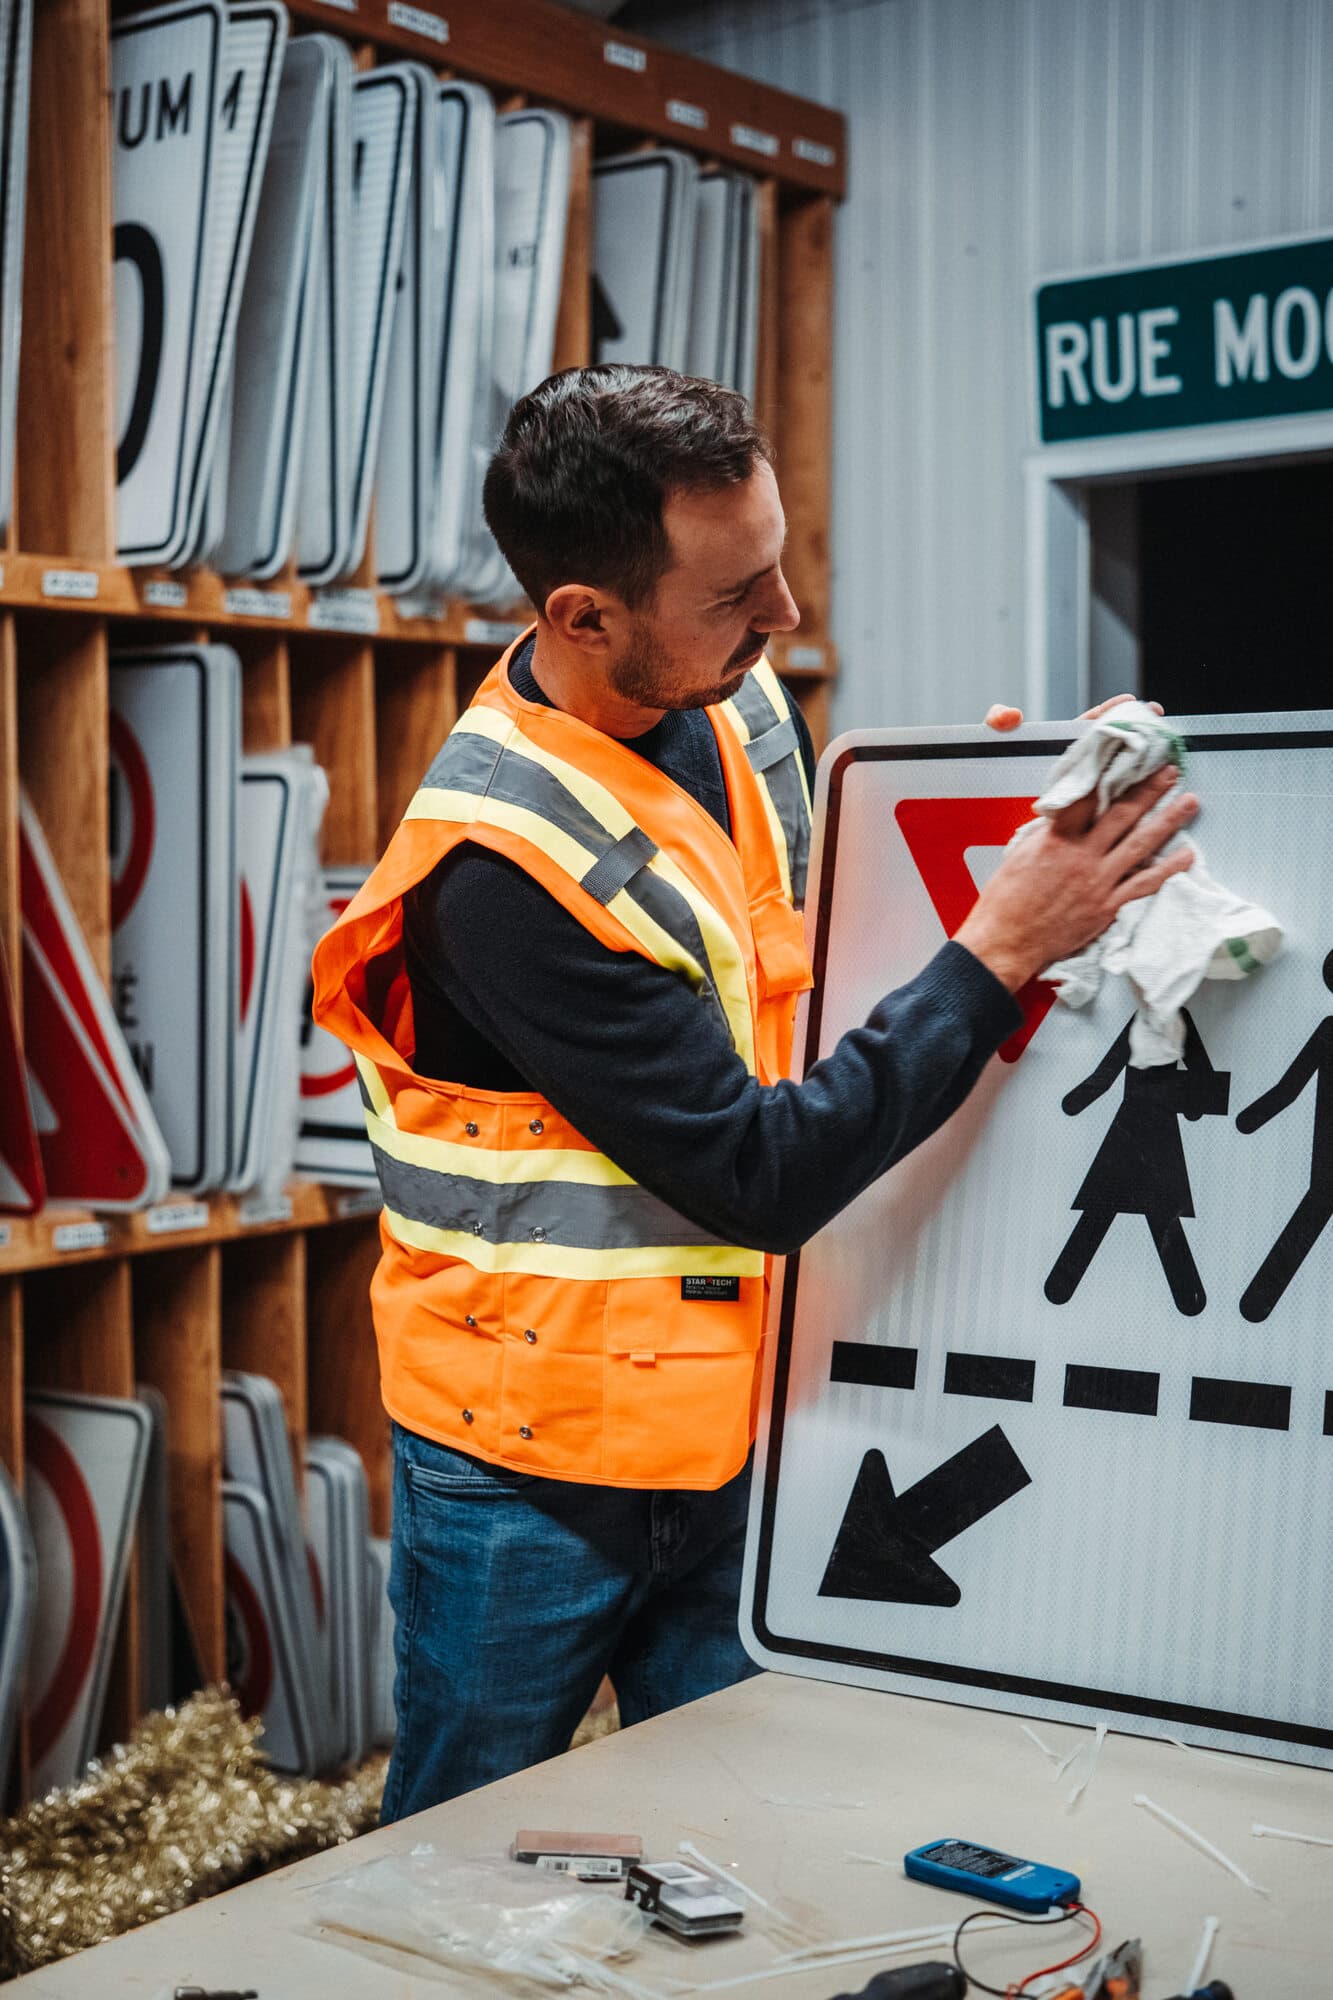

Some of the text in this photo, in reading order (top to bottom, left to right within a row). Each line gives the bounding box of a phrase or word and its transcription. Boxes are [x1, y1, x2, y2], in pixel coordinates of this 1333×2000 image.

[118, 71, 193, 149] UM
[1046, 286, 1333, 408] RUE MO
